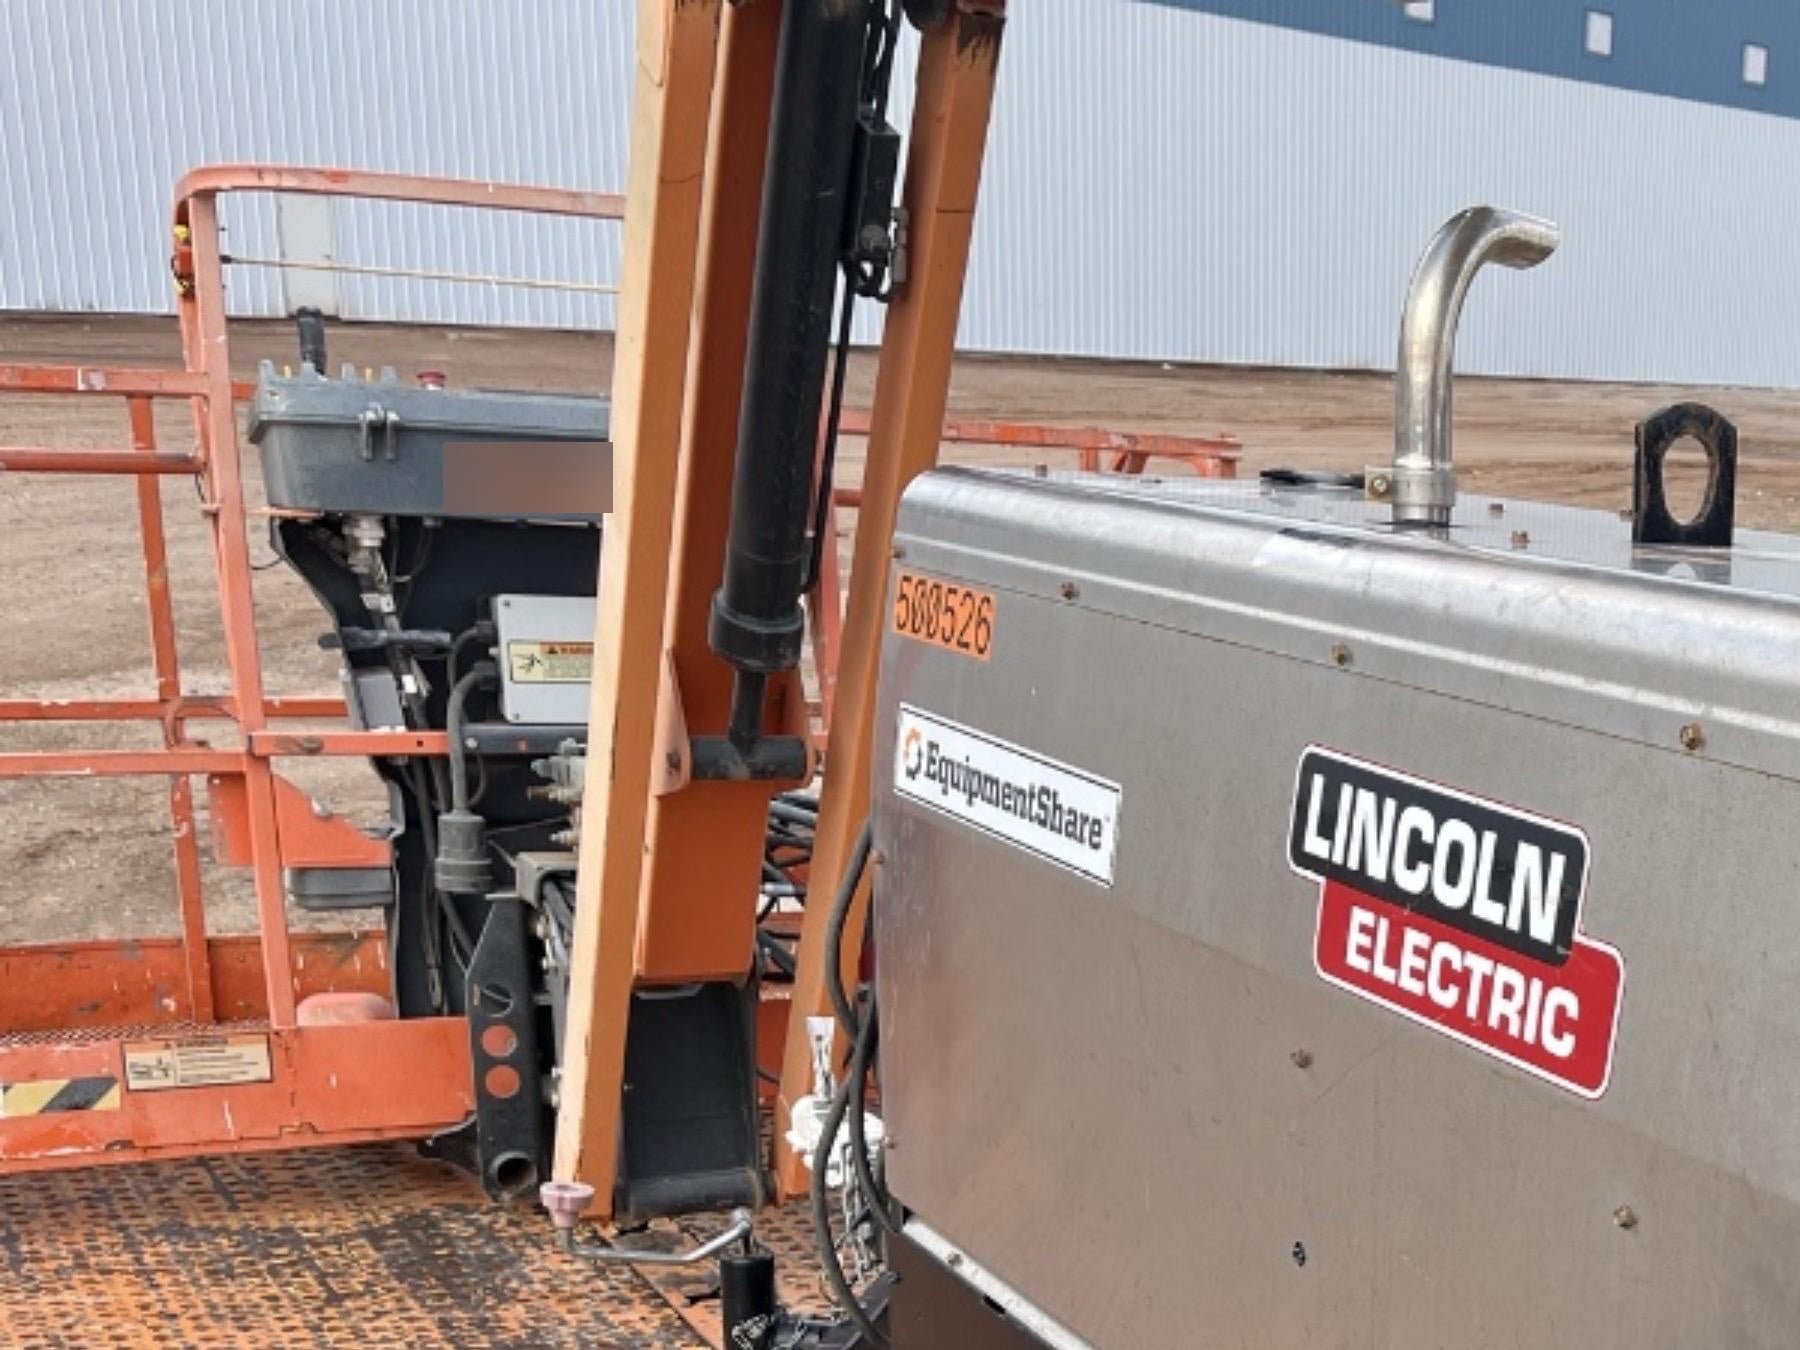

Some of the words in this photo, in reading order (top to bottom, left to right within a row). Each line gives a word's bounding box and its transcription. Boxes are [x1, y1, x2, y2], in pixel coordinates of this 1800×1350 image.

[896, 575, 992, 655] 500526
[923, 739, 1103, 850] EquipmentShare
[1303, 772, 1567, 945] LINCOLN
[1345, 904, 1580, 1058] ELECTRIC
